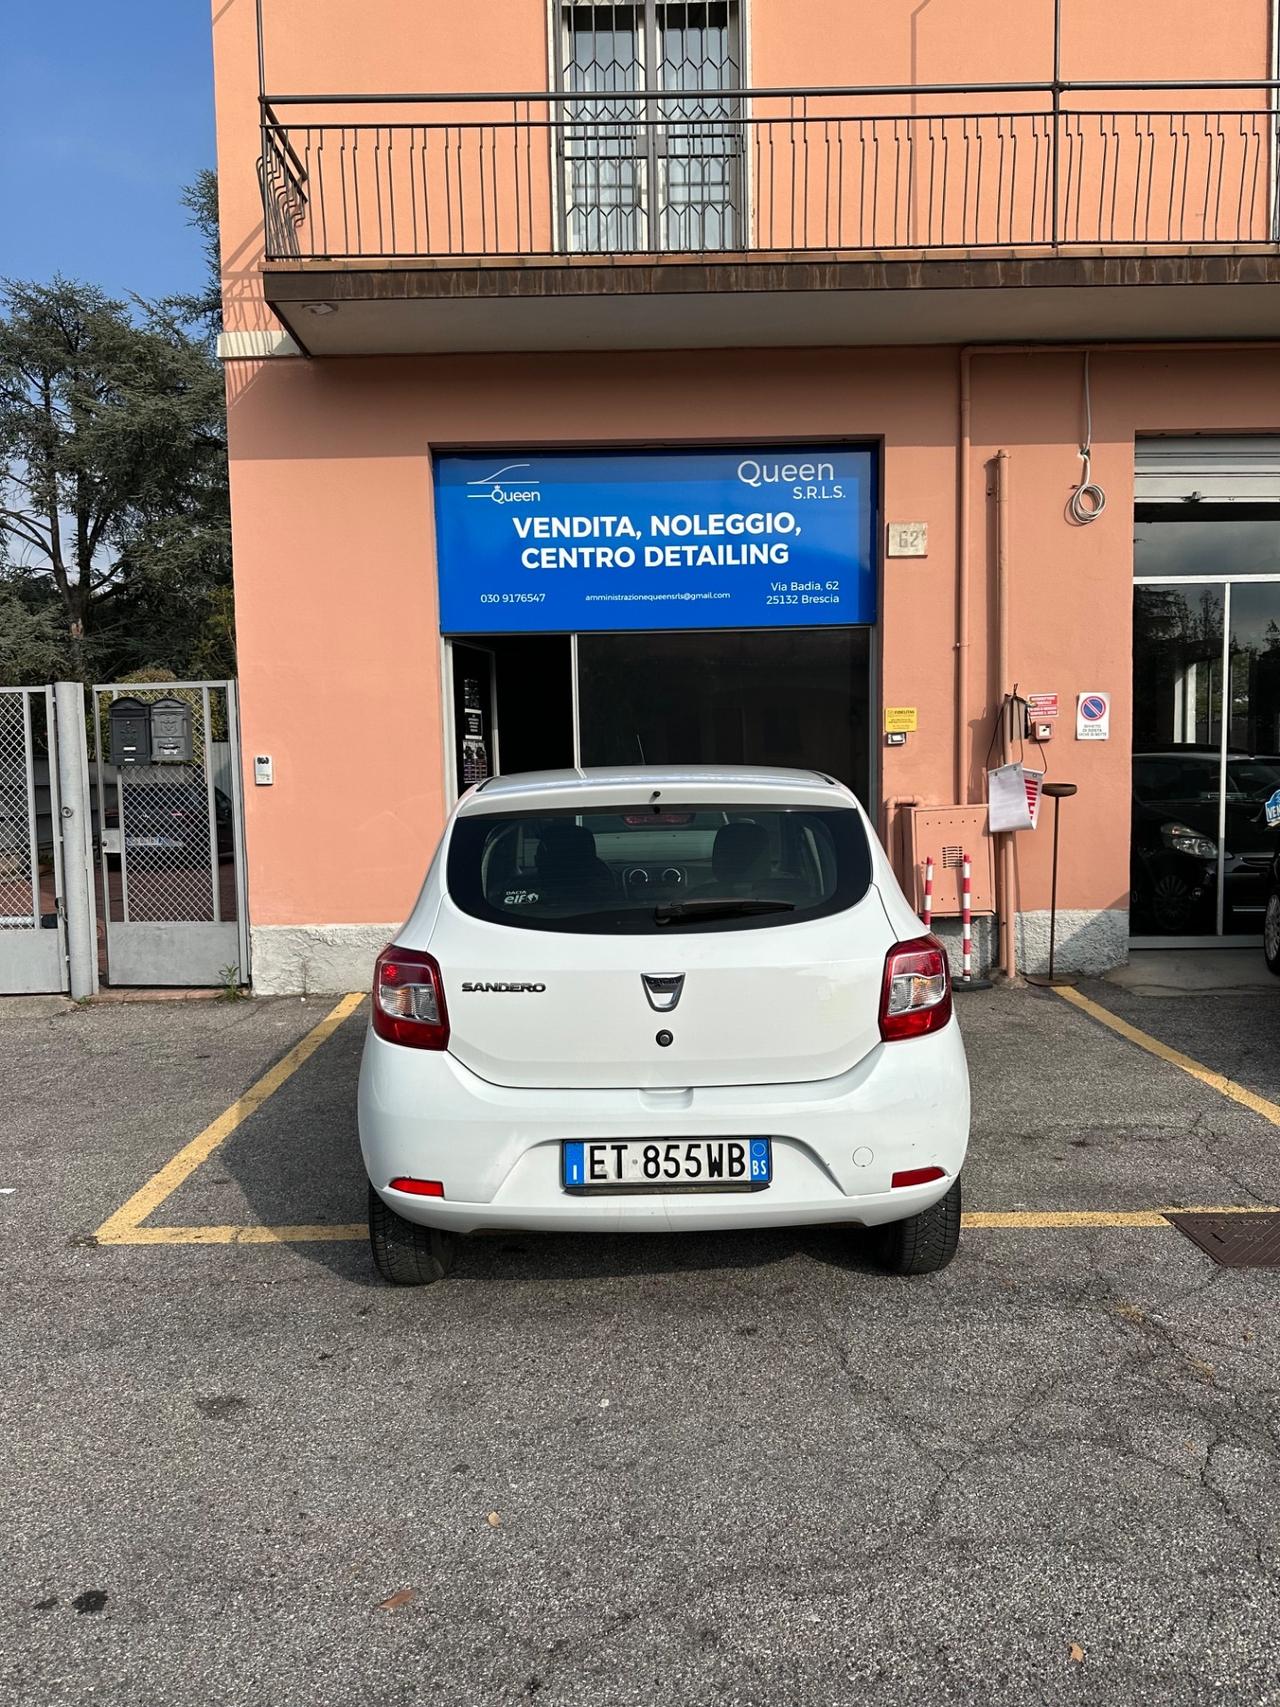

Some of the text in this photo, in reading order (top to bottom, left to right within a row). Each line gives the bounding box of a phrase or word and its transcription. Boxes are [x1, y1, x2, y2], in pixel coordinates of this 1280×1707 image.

[738, 460, 834, 488] Queen
[491, 488, 541, 504] Queen
[793, 485, 846, 500] S.R.L.S.
[512, 511, 802, 540] VENDITA, NOLEGGIO,
[521, 543, 789, 569] CENTRO DETAILING
[770, 582, 787, 592] Via
[825, 580, 839, 590] 62
[480, 593, 546, 603] 030 9176547
[585, 591, 731, 602] amministrazionequeensrls@gmail.com
[766, 594, 840, 605] 25132 Brescia
[504, 895, 527, 904] elf
[461, 982, 547, 993] SANDERO
[589, 1144, 628, 1180] ET
[642, 1143, 746, 1179] 855WB
[752, 1159, 768, 1176] BS
